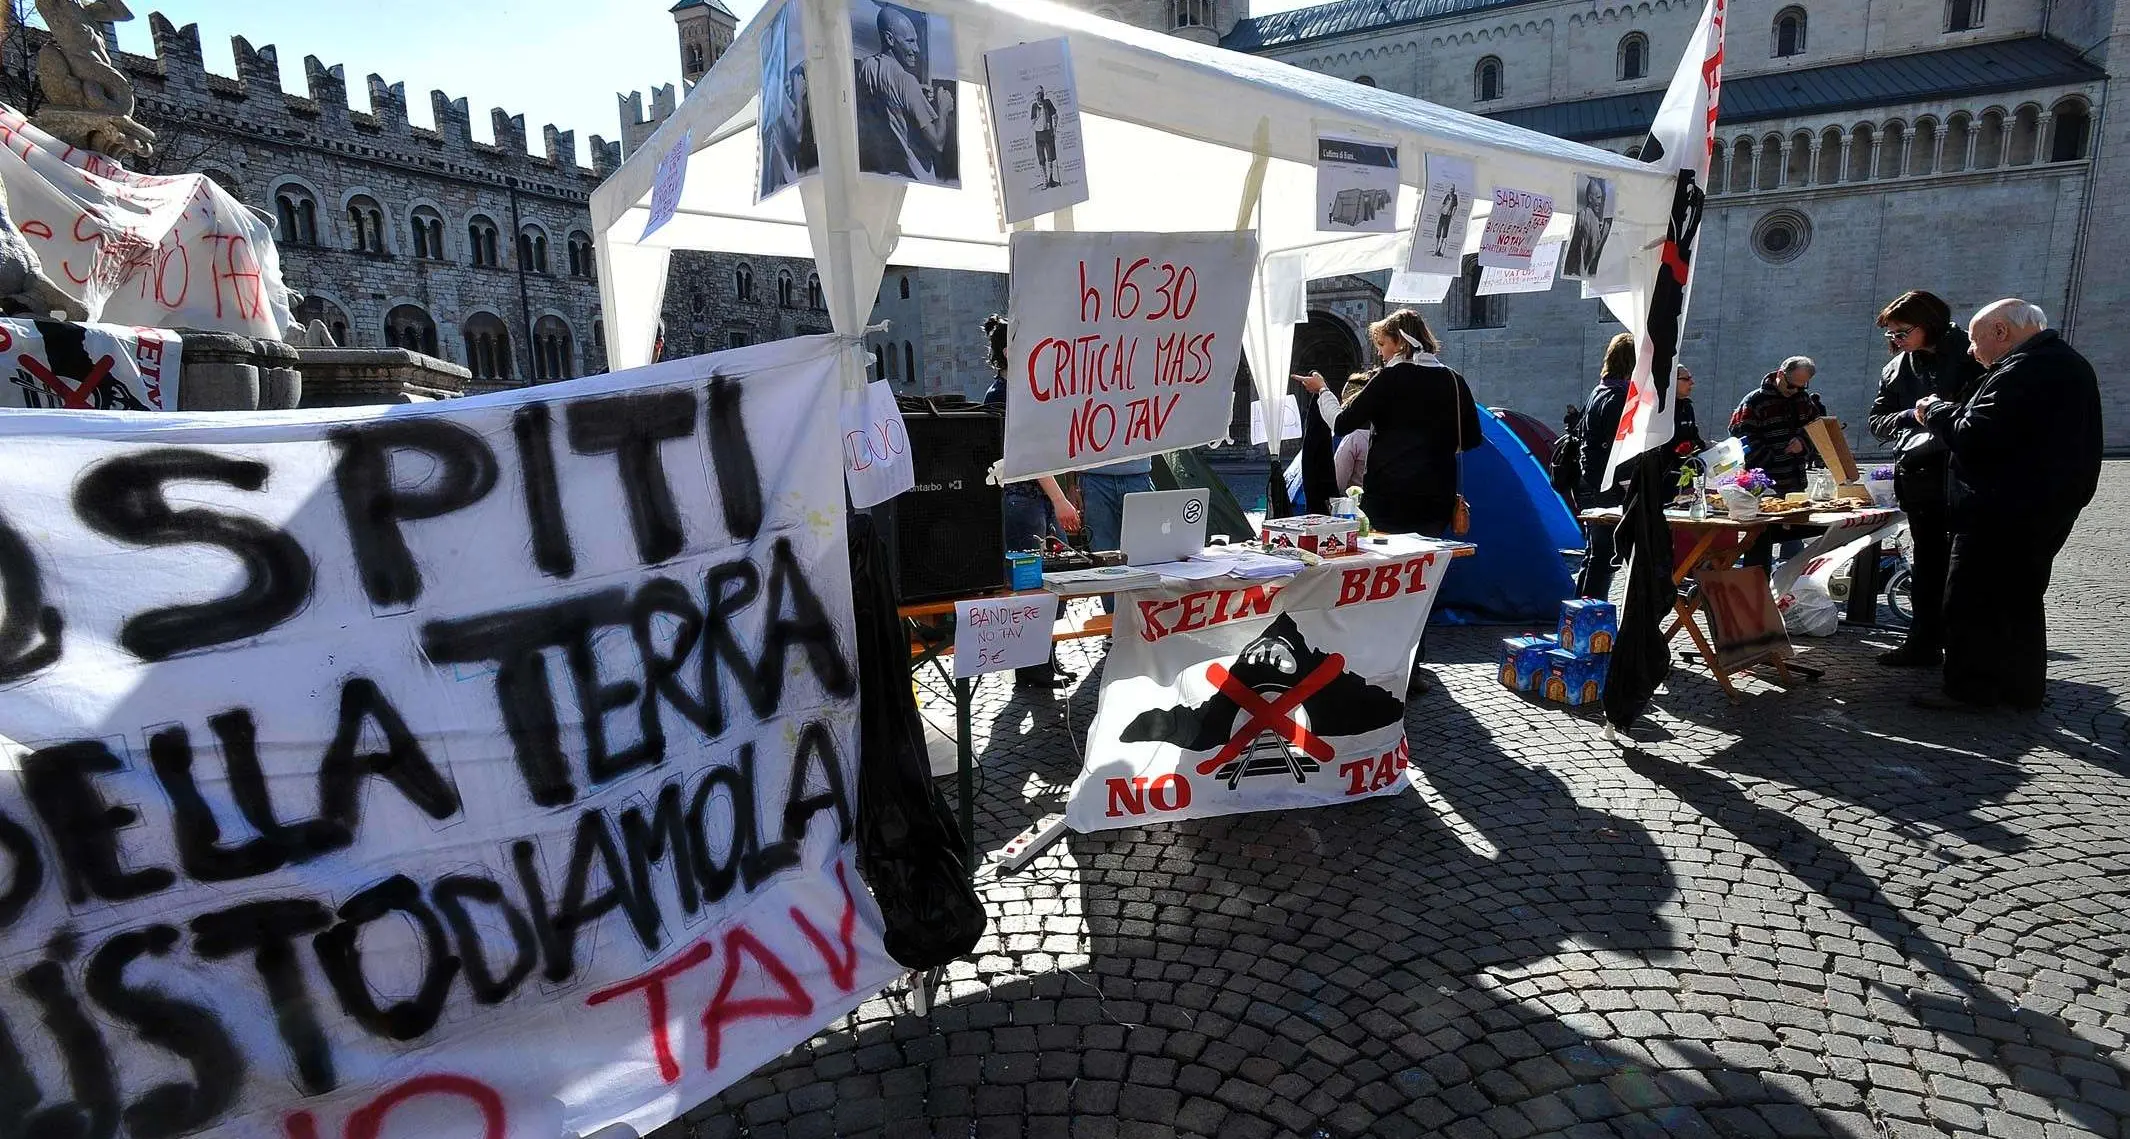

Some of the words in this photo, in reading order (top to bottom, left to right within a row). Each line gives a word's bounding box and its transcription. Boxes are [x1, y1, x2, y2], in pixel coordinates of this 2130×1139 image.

[1496, 190, 1531, 209] SABATO
[1497, 234, 1509, 245] NO
[1511, 236, 1525, 247] TAV
[1079, 261, 1101, 322] h
[1028, 335, 1138, 402] CRITICAL
[1155, 332, 1215, 386] MASS
[1069, 398, 1116, 459] NO
[1125, 394, 1180, 446] TAV
[906, 482, 942, 493] ontarbo
[969, 606, 1041, 628] BANDIERE
[1138, 585, 1285, 642] KEIN
[1335, 554, 1434, 607] BBT
[978, 628, 995, 644] NO
[1001, 626, 1024, 640] TAV
[422, 537, 856, 805] TERRA
[976, 648, 988, 667] 5
[1106, 773, 1192, 817] NO
[586, 860, 860, 1084] TAV
